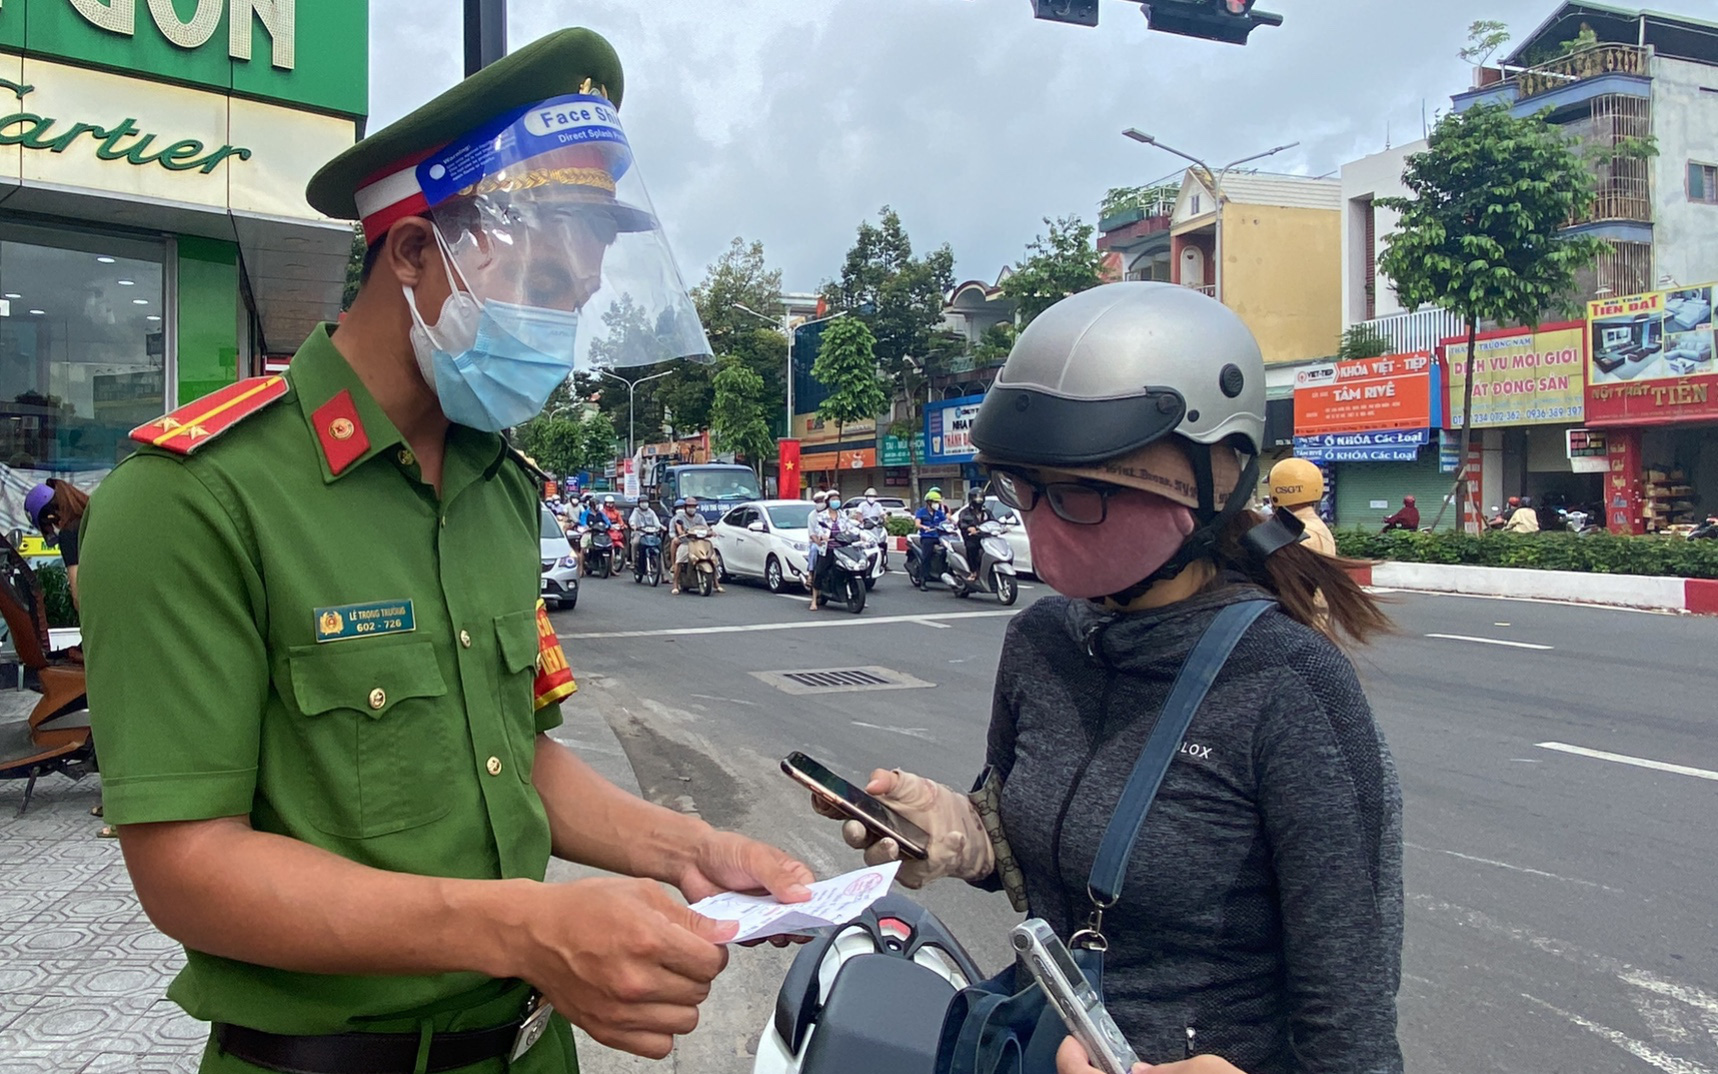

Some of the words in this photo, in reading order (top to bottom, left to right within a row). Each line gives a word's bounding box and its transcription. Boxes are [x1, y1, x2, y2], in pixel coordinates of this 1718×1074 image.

[540, 108, 591, 128] Face
[558, 131, 588, 143] Direct
[1340, 362, 1368, 377] KHÓA
[1333, 386, 1361, 402] TÂM
[1473, 380, 1488, 397] ẤT
[1374, 433, 1396, 443] Các
[1337, 449, 1368, 460] KHÓA
[1370, 450, 1392, 459] Các
[1275, 485, 1303, 494] CSGT
[357, 621, 375, 632] 602
[1177, 742, 1212, 759] LOX
